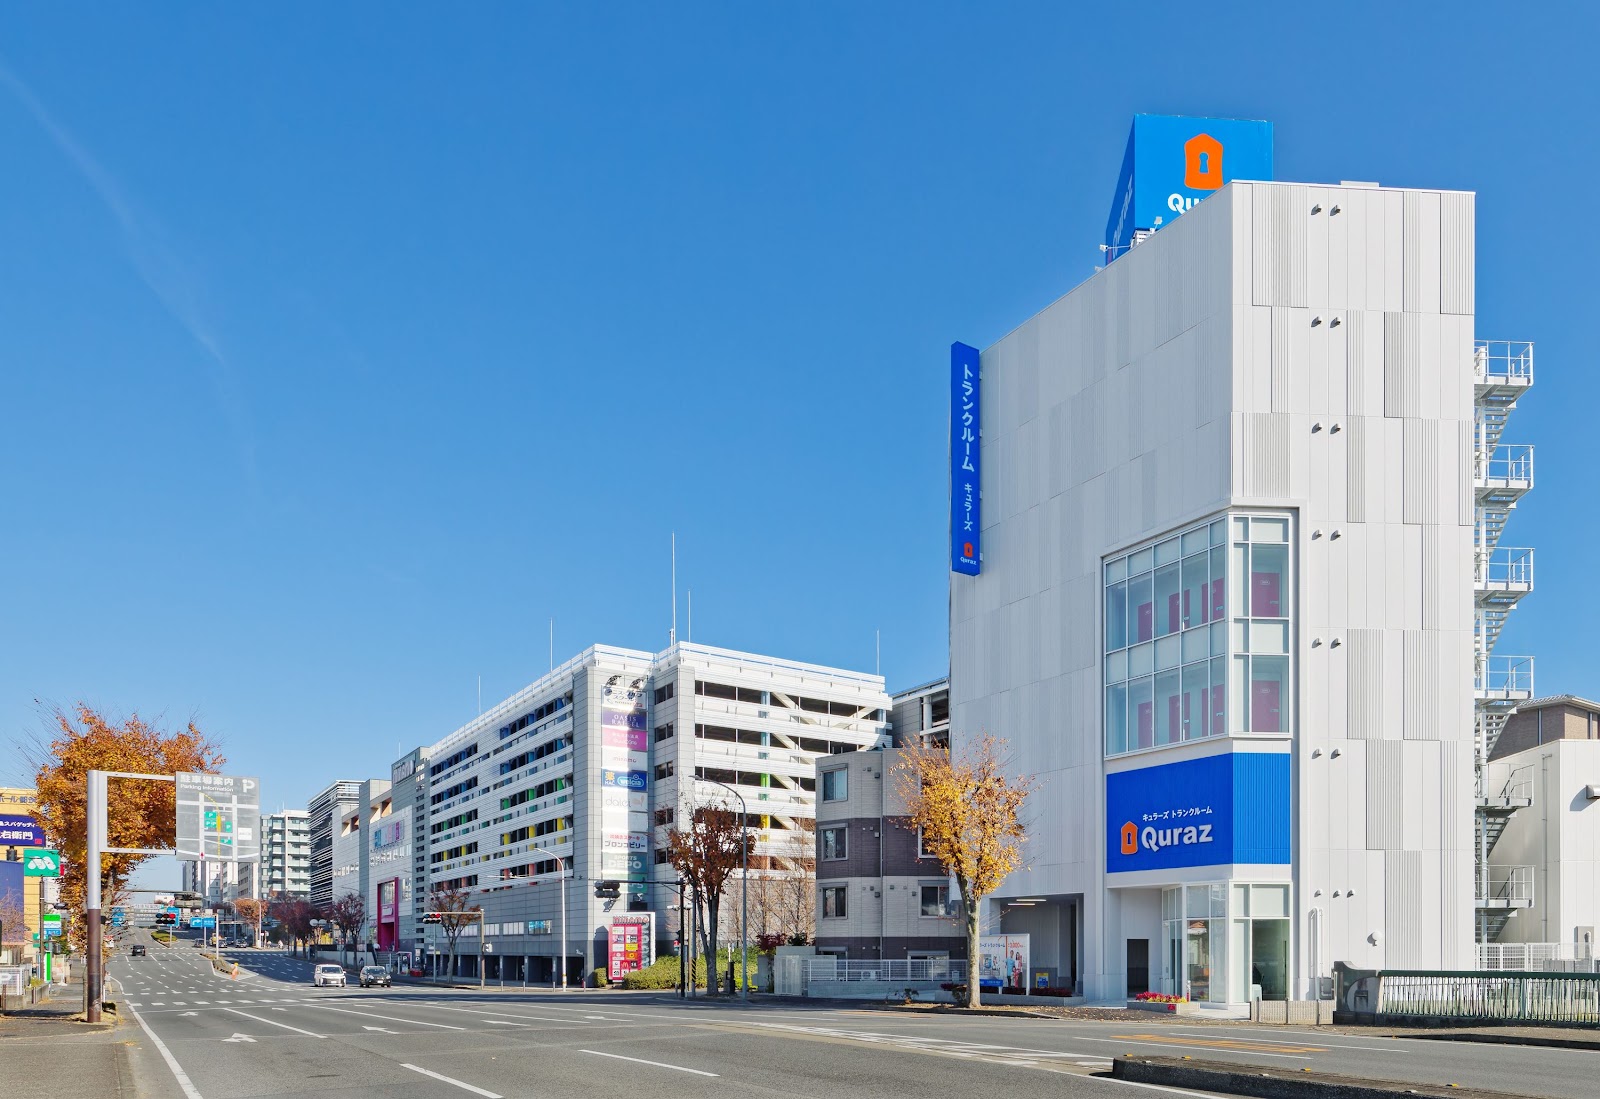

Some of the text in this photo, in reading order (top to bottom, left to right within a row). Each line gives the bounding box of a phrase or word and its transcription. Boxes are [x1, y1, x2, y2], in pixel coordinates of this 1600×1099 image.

[1167, 193, 1204, 215] Qu
[961, 363, 975, 532] トランクルーム キュラーズ
[959, 556, 977, 566] Quraz
[613, 714, 637, 722] OASIS
[180, 774, 234, 787] 駐車場案内
[1142, 806, 1213, 822] キュラーズ トランクルーム
[604, 840, 646, 849] ブロンコビリー
[1141, 824, 1213, 852] Quraz
[608, 859, 642, 870] DEPO
